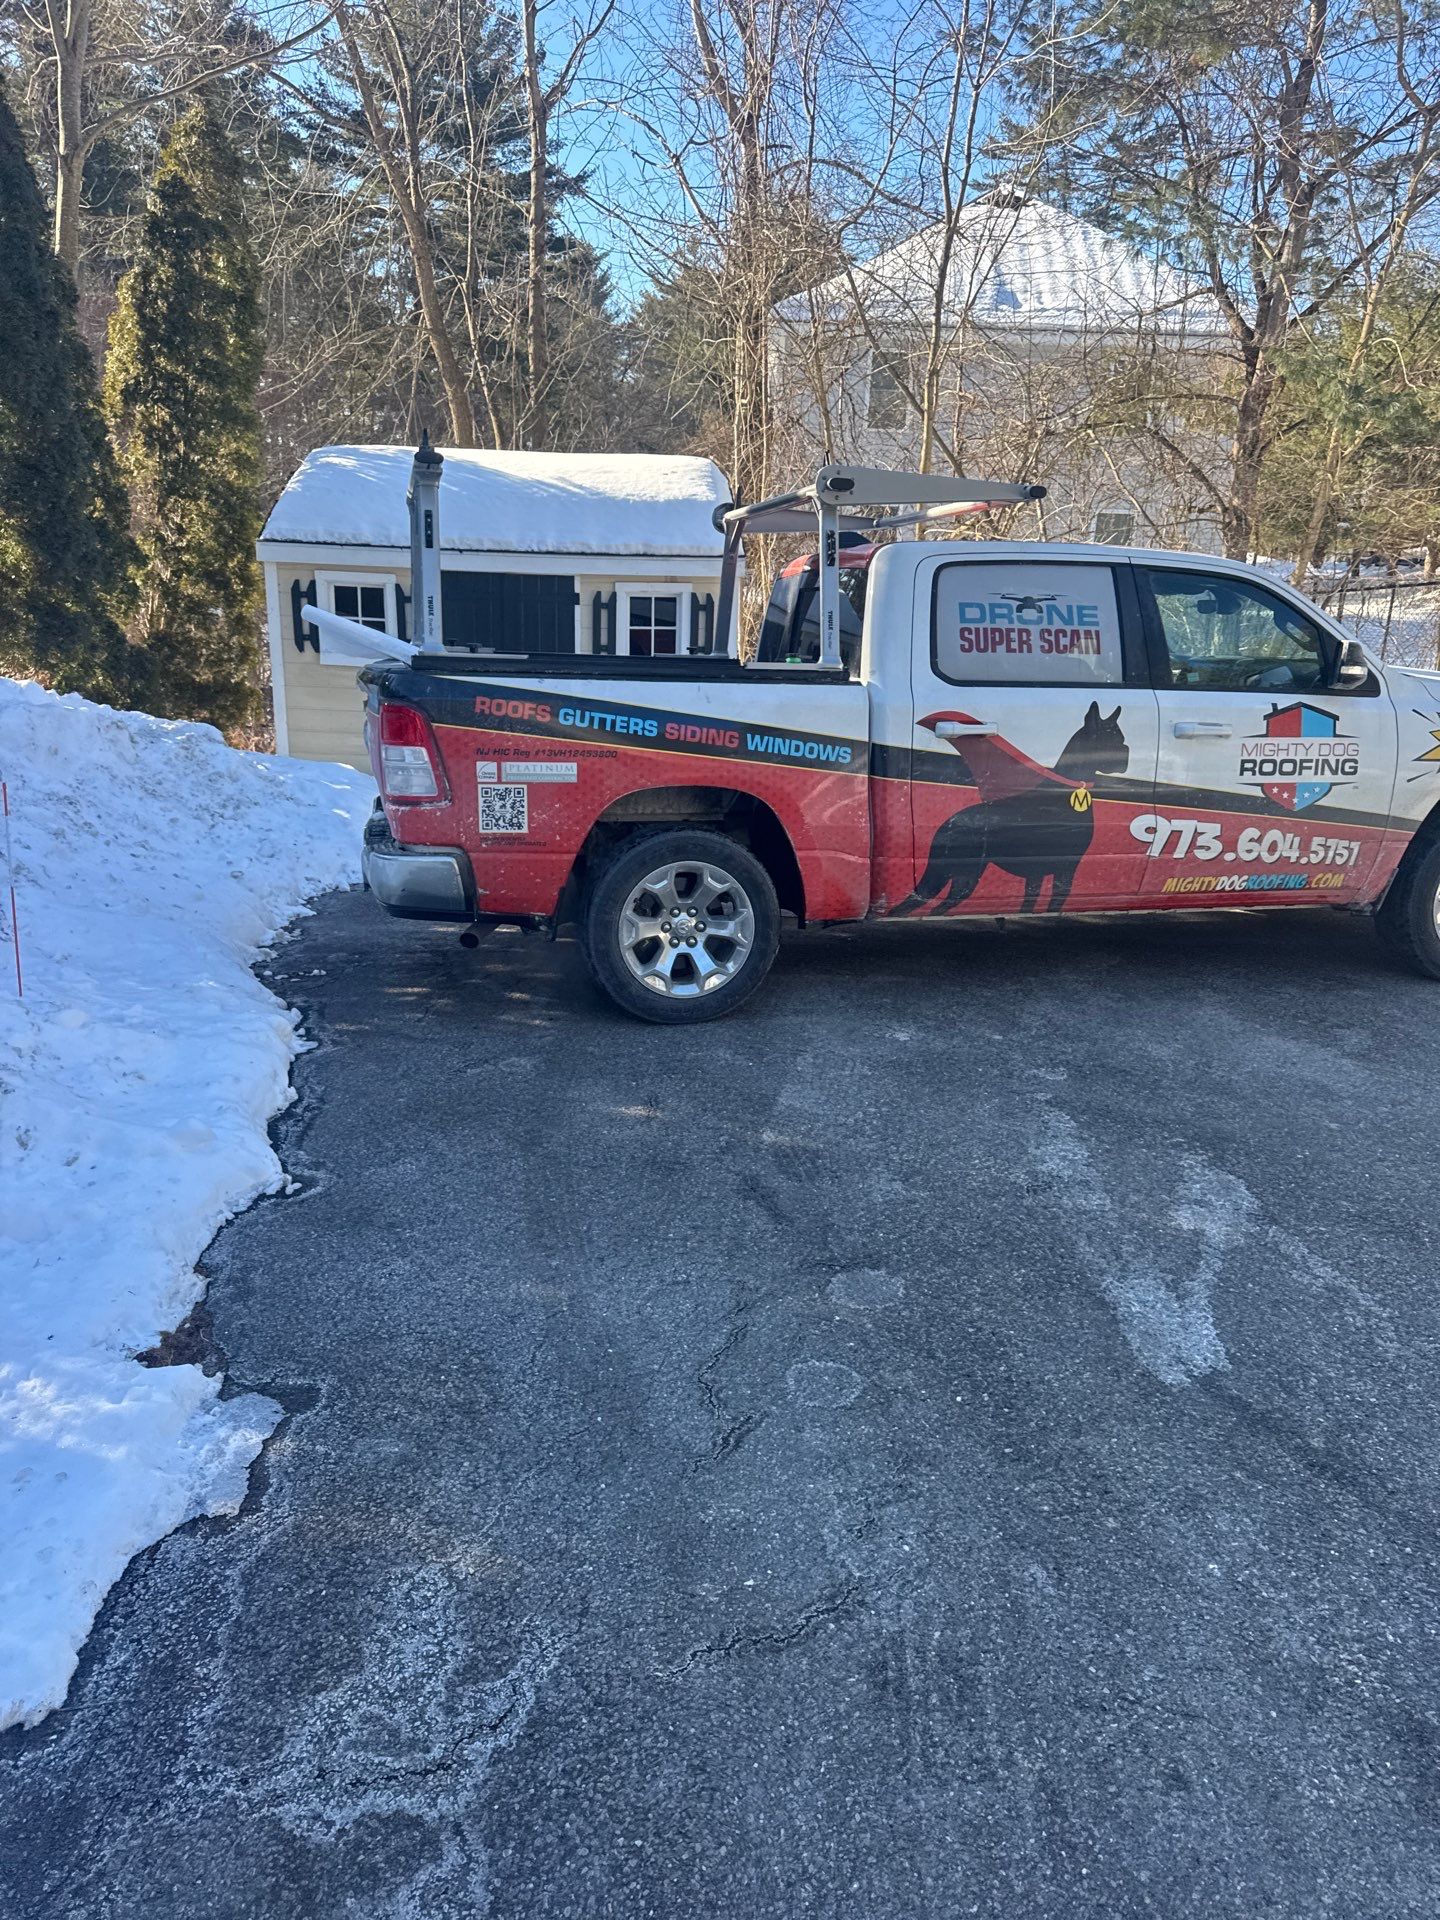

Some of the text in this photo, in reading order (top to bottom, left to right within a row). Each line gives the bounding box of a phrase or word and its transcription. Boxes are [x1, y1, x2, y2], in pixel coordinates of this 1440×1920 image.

[427, 595, 435, 617] THULE
[958, 602, 1100, 627] DRONE
[959, 627, 1101, 655] SUPER SCAN
[474, 695, 852, 764] ROOFS GUTTERS SIDING WINDOWS
[476, 747, 489, 756] NJ
[493, 747, 510, 756] HIC
[513, 748, 531, 758] Reg
[1240, 742, 1360, 757] MIGHTY DOG
[508, 764, 575, 773] PLATINUM
[1238, 758, 1359, 777] ROOFING
[1072, 791, 1090, 808] M
[1129, 813, 1361, 866] 973.604.5751
[1161, 872, 1345, 893] MIGHTYDOGROOFING.COM
